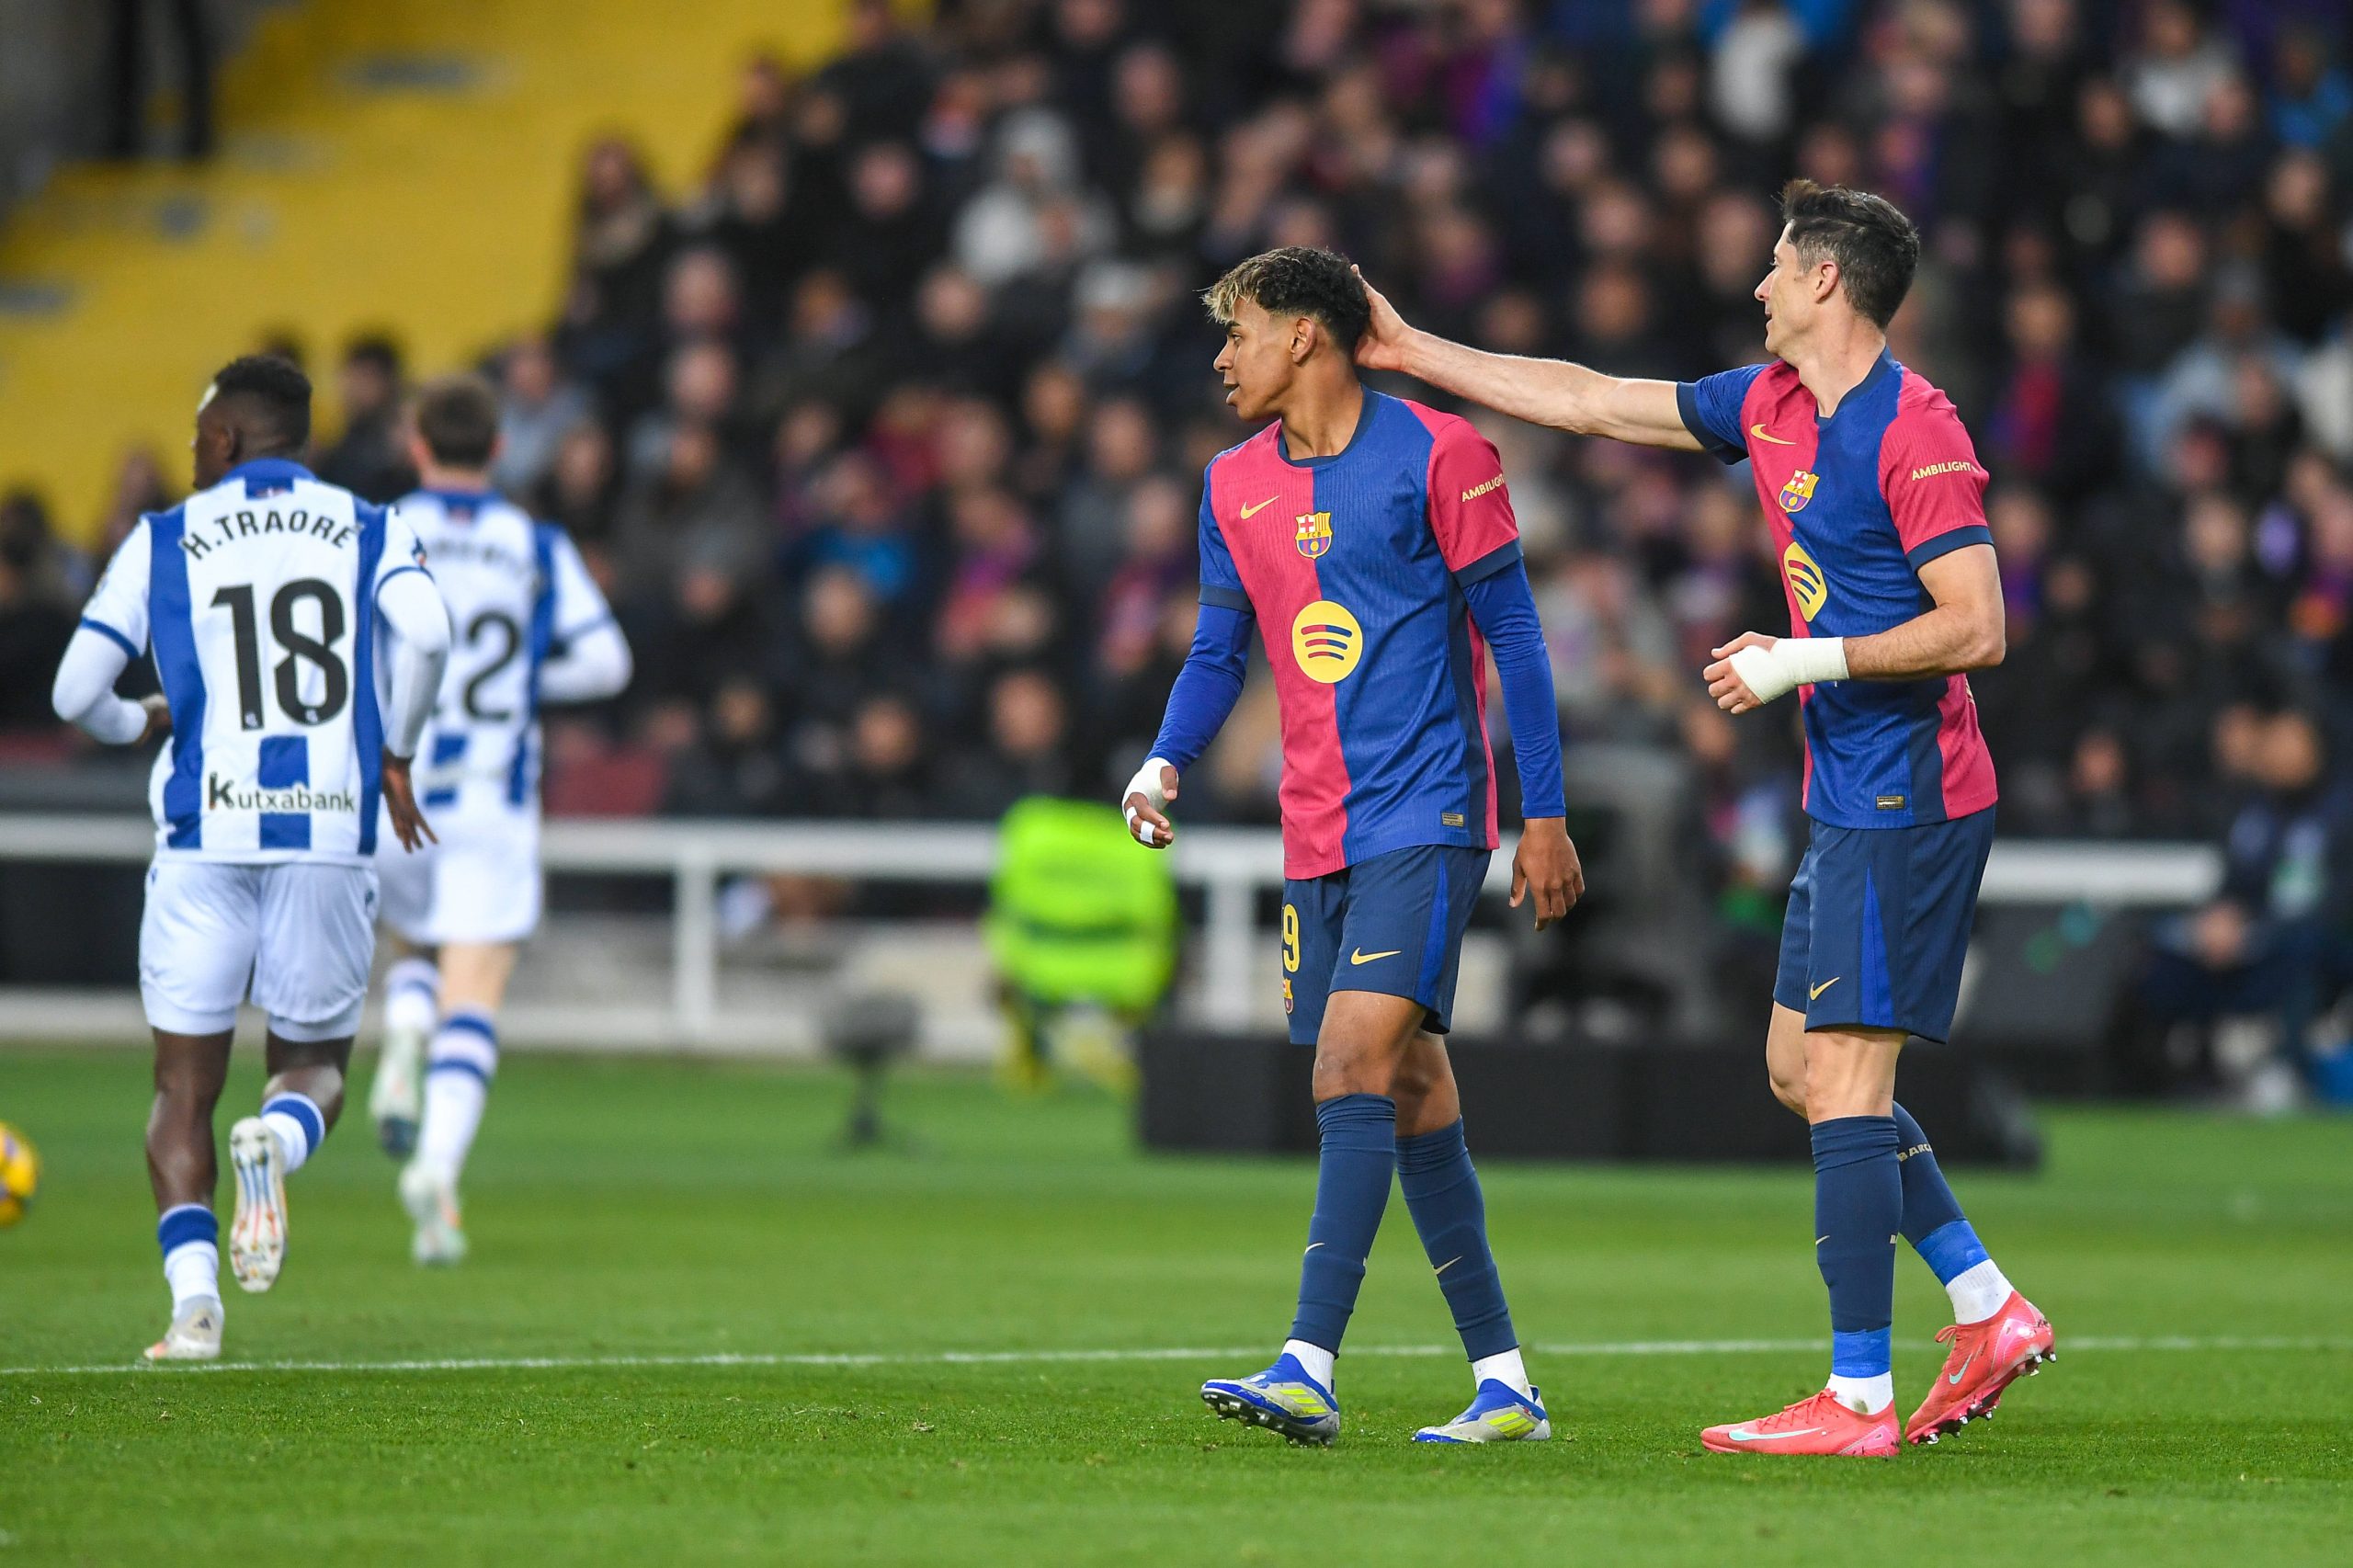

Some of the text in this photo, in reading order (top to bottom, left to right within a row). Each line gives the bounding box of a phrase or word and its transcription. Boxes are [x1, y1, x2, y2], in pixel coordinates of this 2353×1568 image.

[1912, 461, 1971, 481] AMBILIGHT
[210, 577, 348, 732] 18
[449, 610, 522, 722] 2
